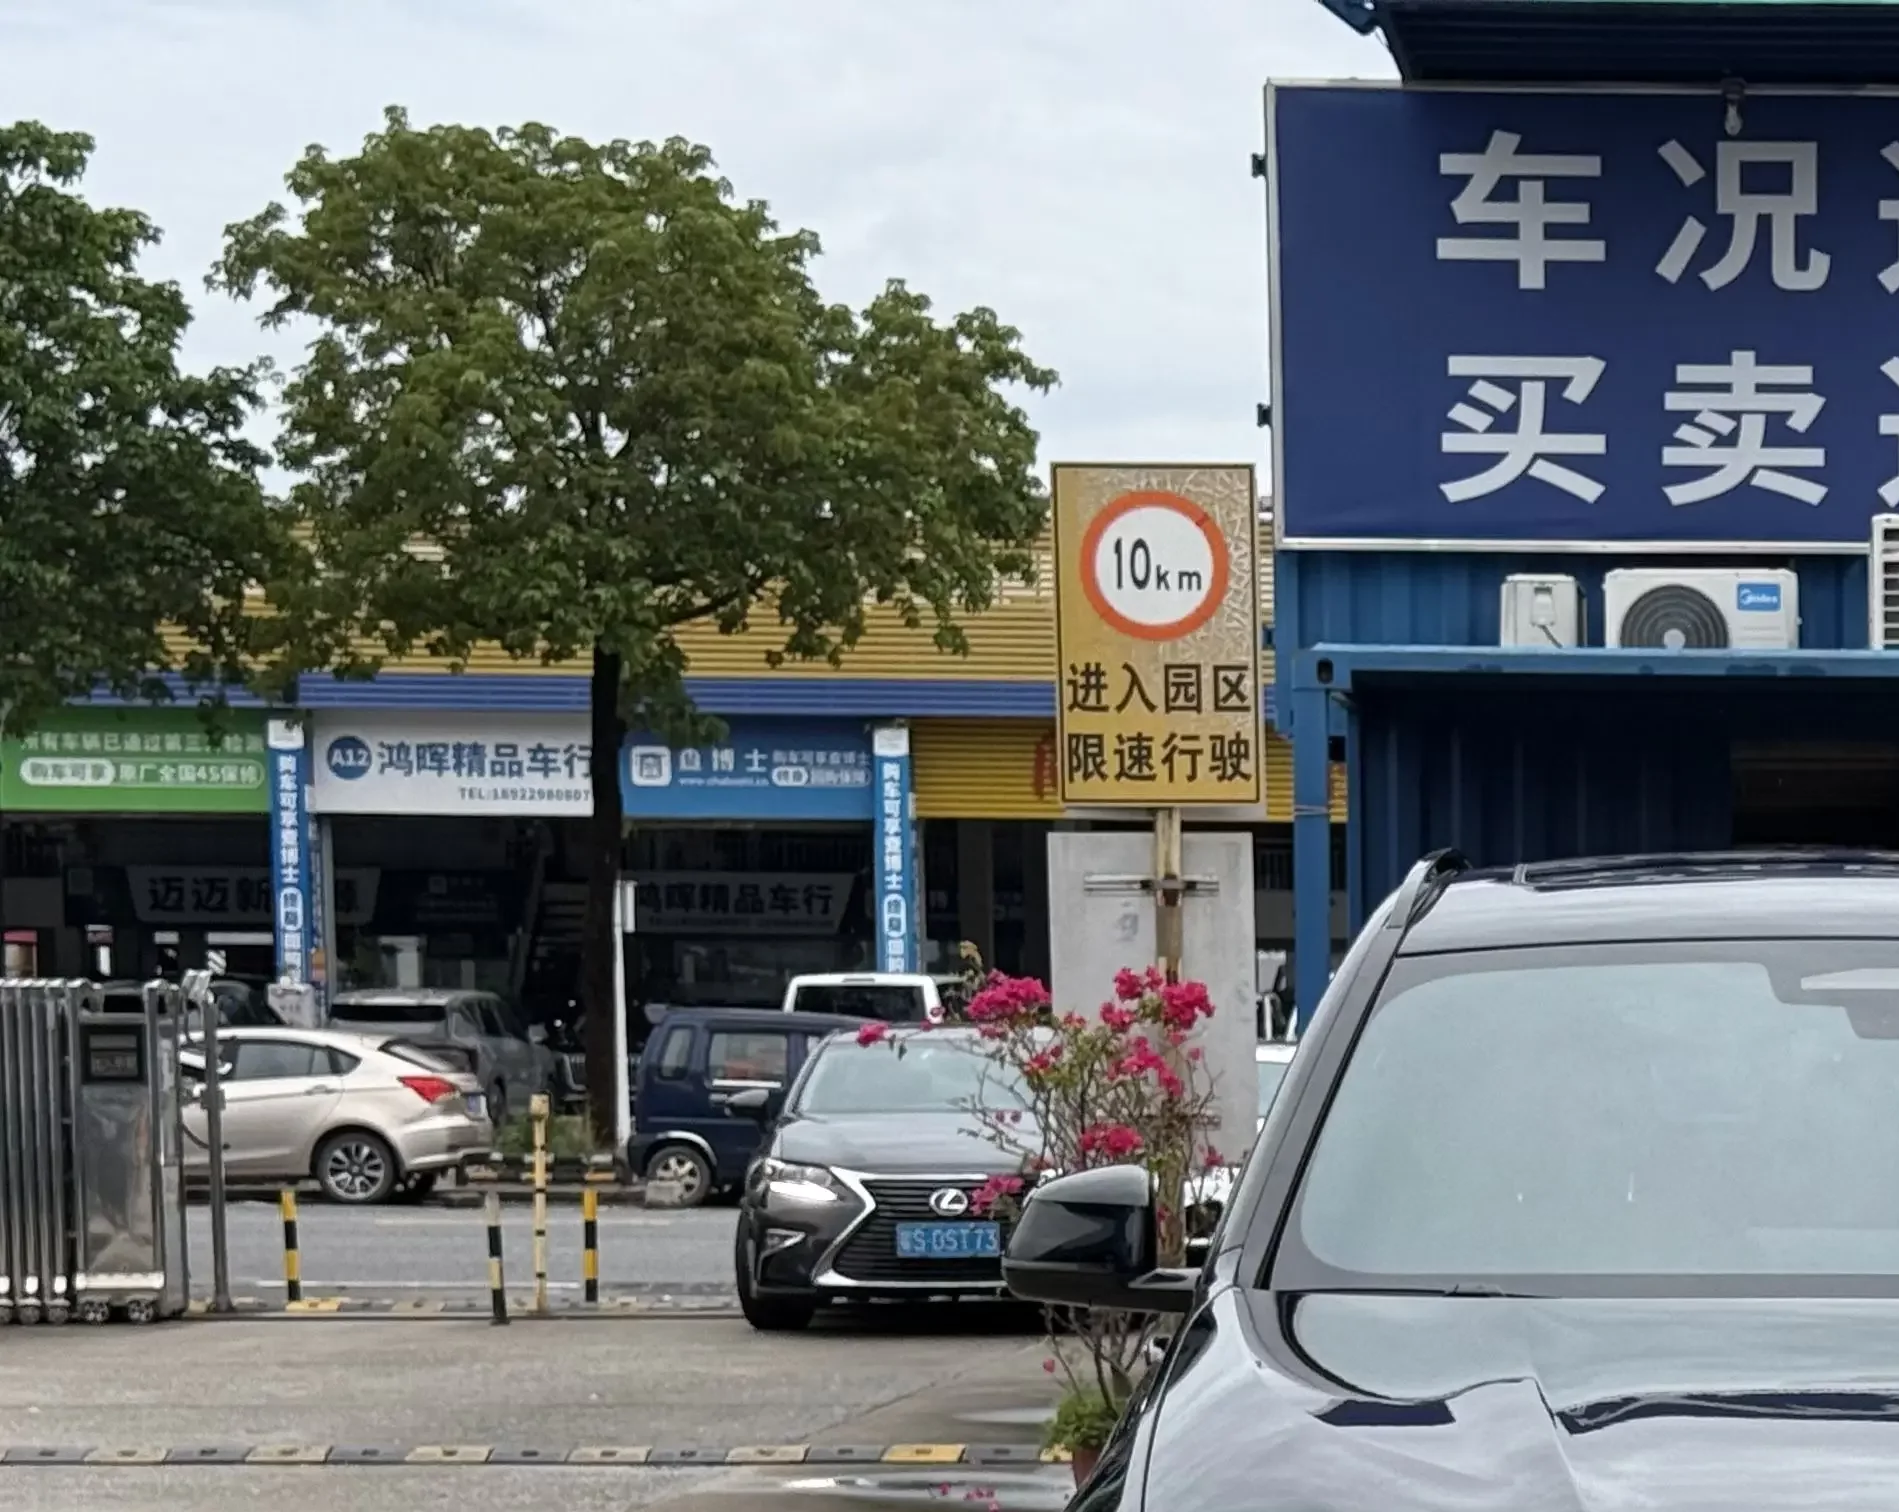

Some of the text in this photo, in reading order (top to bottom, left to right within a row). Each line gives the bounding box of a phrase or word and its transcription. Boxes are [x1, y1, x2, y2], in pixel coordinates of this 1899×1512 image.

[1113, 537, 1202, 592] 10km
[1066, 662, 1252, 714] 进入园区
[330, 748, 369, 768] A12
[377, 740, 592, 779] 鸿晖精品车行
[1067, 732, 1253, 784] 限速行驶
